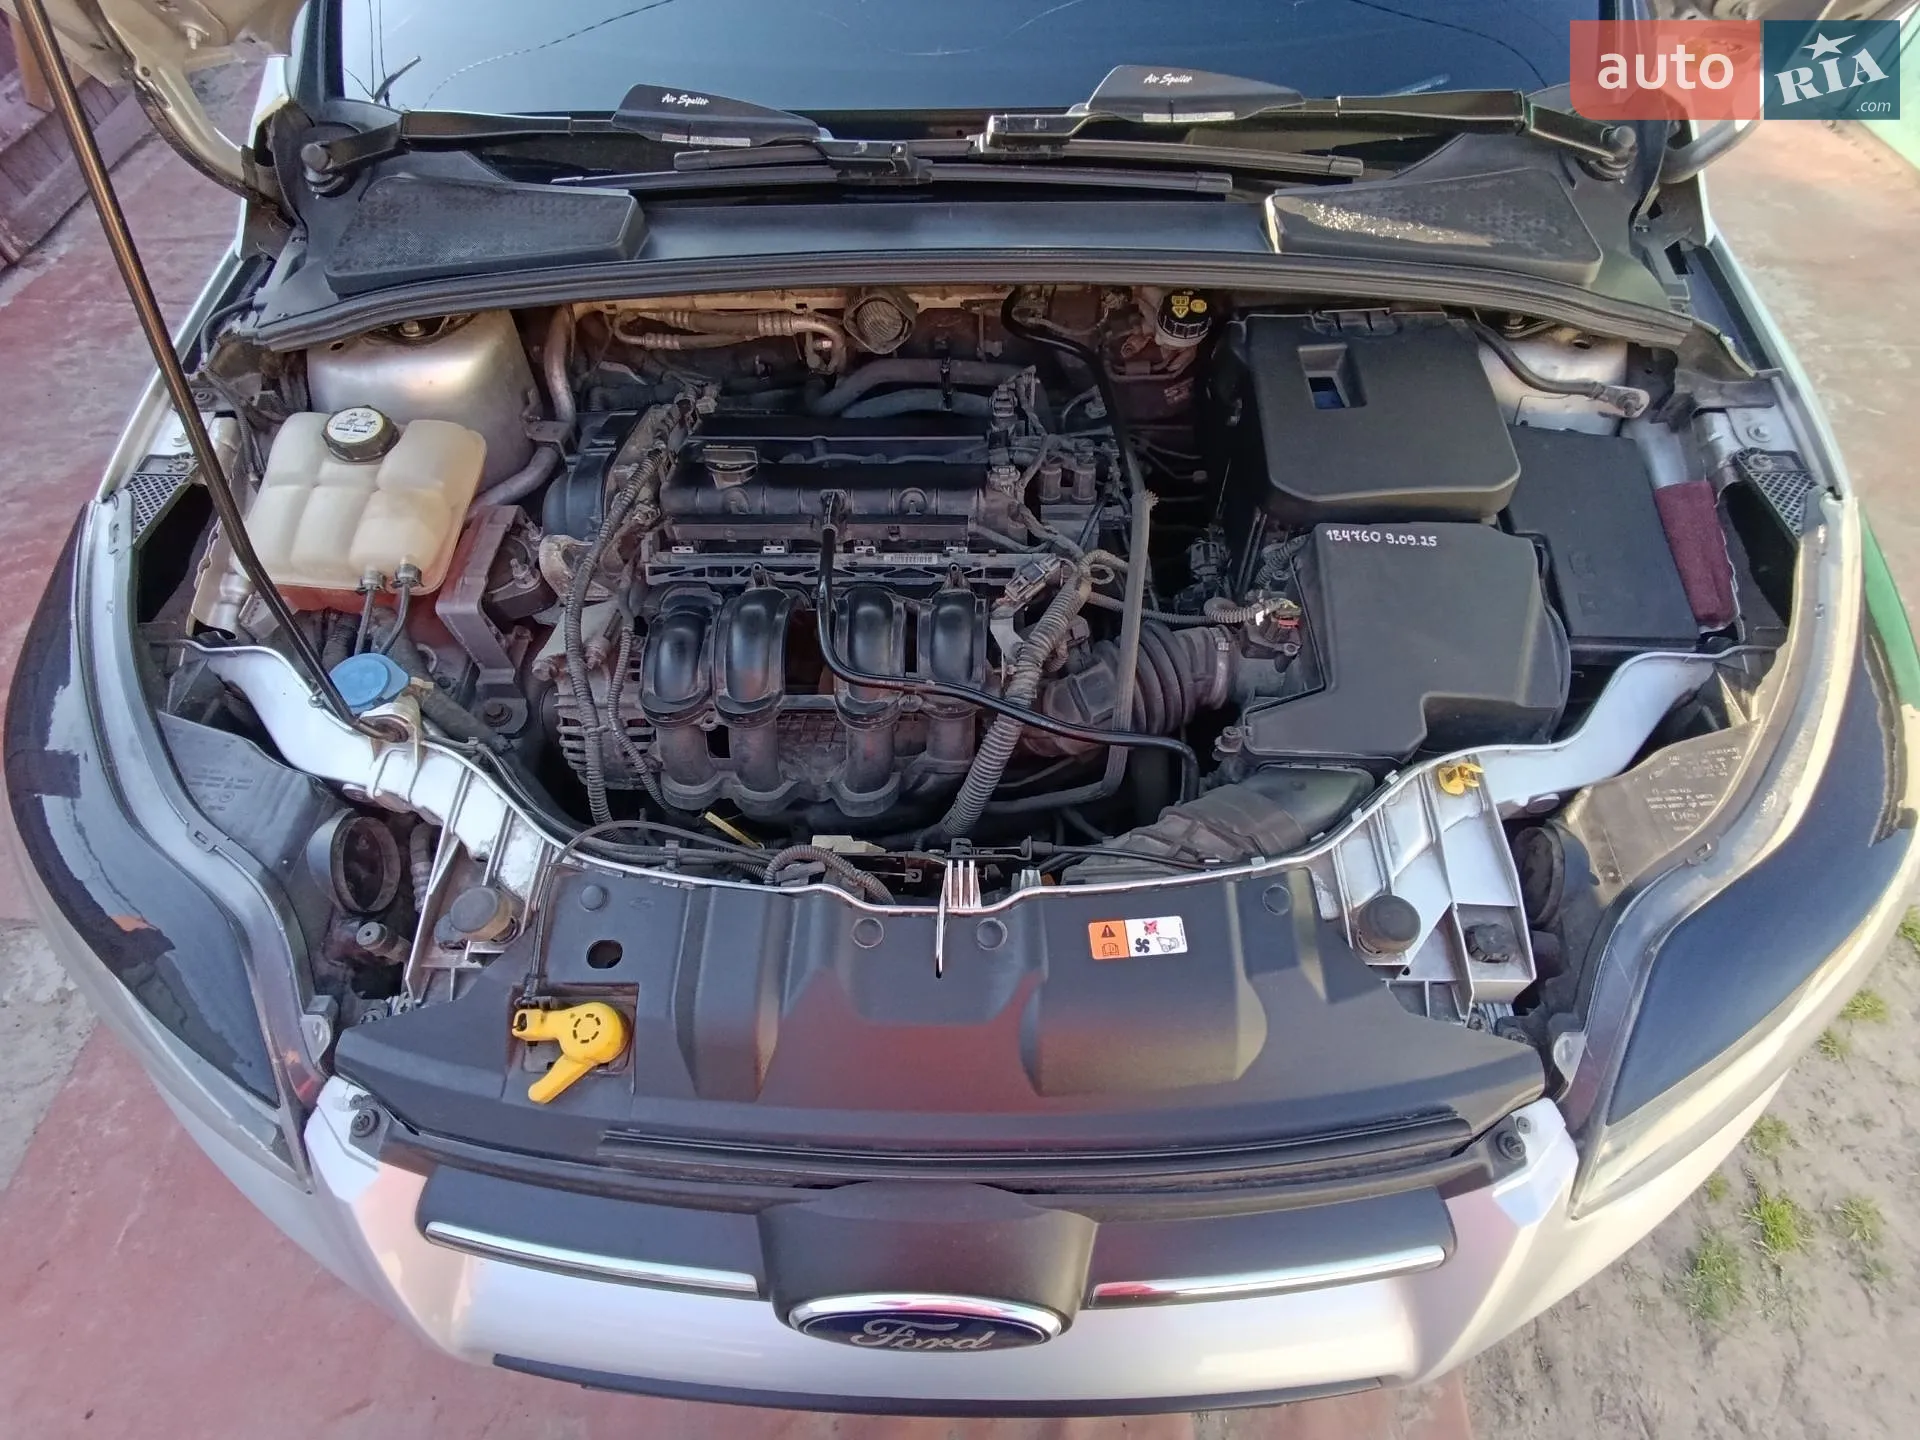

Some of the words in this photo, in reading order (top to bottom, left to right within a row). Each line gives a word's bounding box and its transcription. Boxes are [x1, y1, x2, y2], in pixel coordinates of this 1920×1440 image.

[1143, 73, 1159, 84] Air
[661, 92, 677, 103] Air
[851, 1318, 996, 1350] Ford
